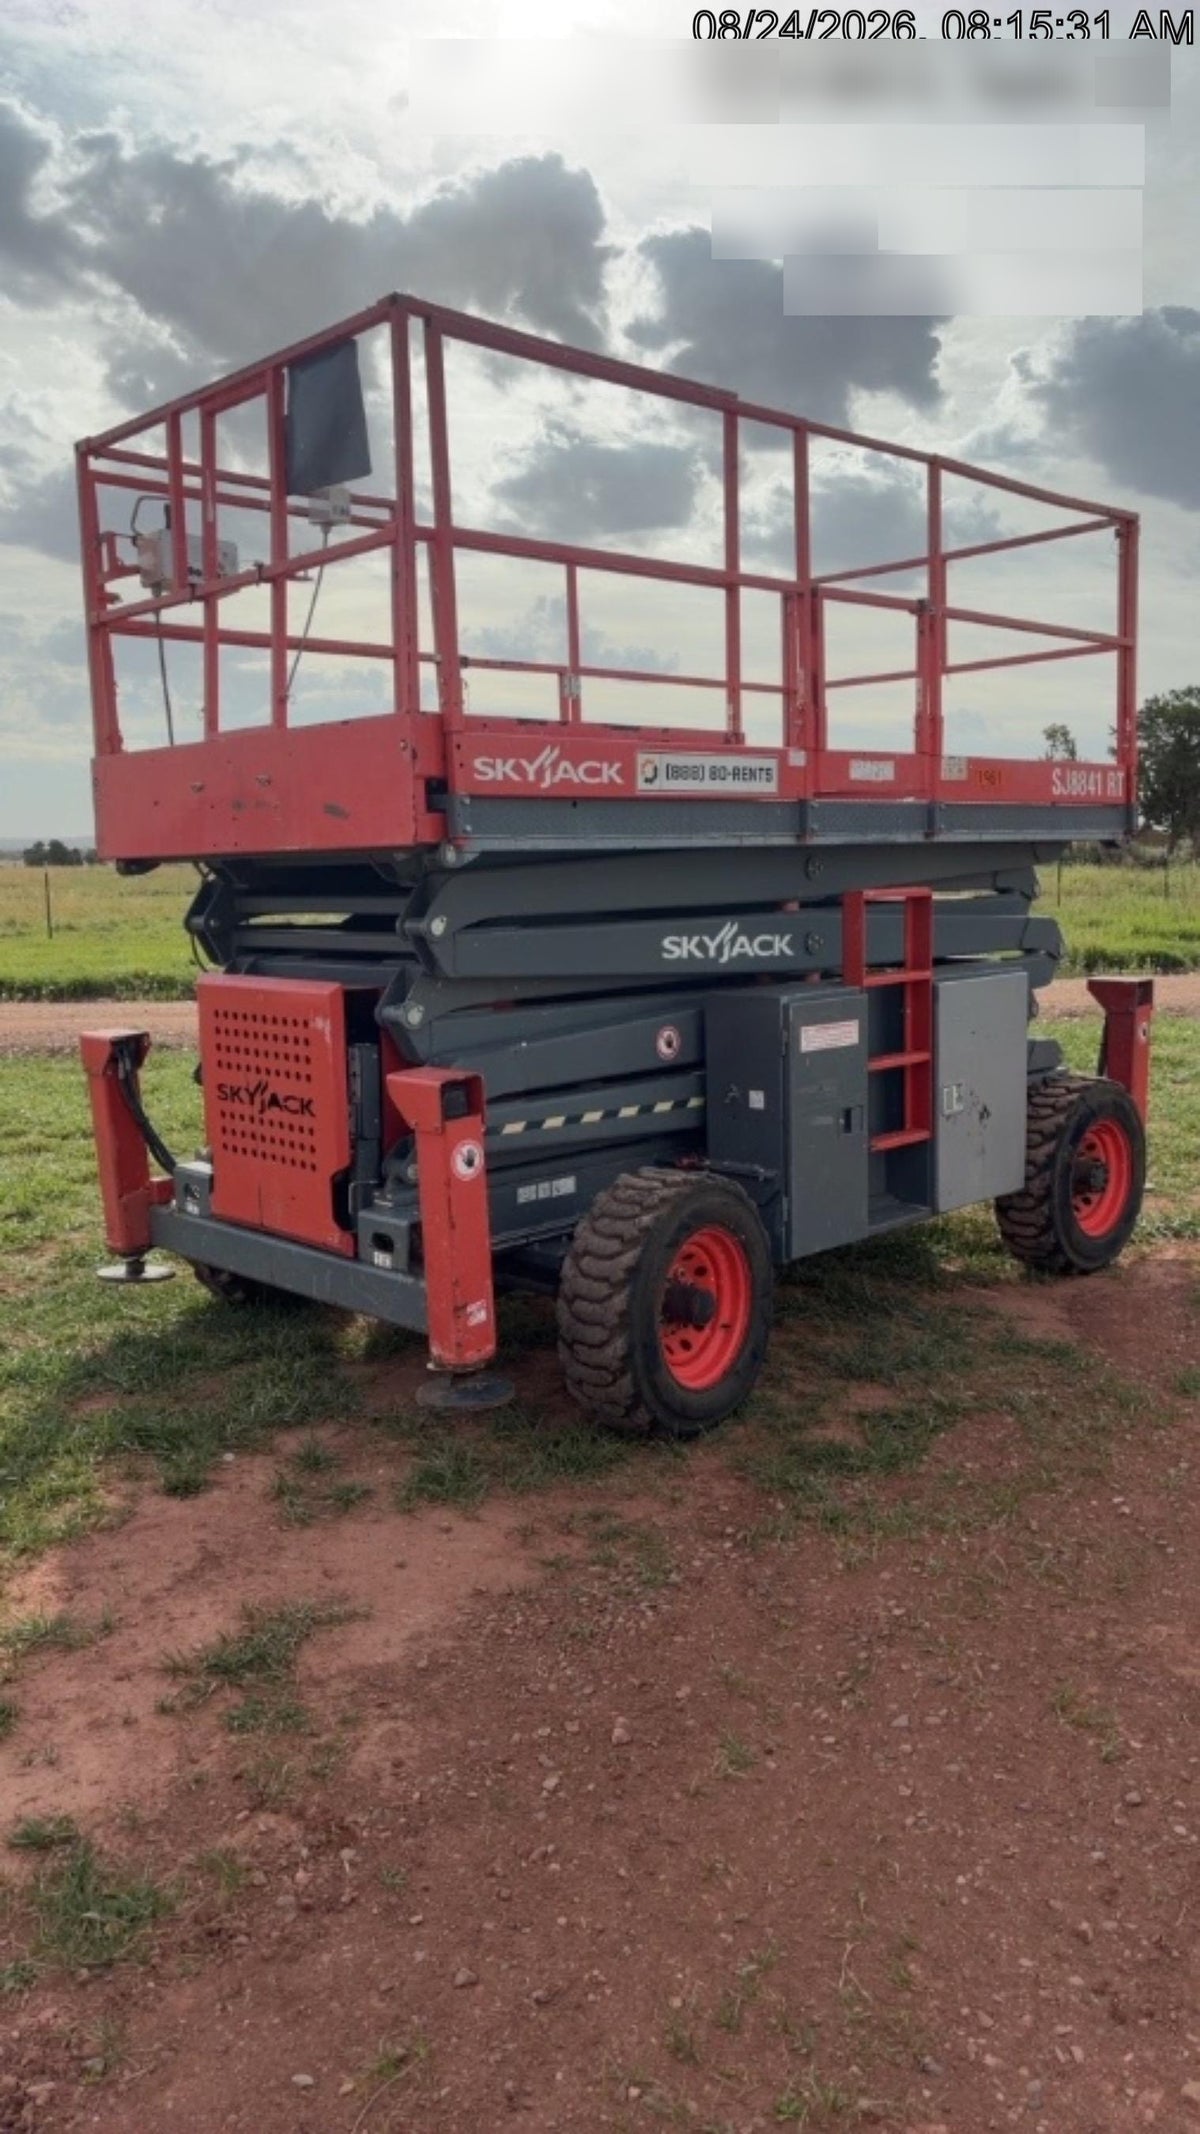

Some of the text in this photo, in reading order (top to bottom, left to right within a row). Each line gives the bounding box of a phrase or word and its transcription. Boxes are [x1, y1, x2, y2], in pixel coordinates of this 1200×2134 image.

[473, 745, 623, 788] SKYJACK
[665, 763, 774, 783] (888) 80-RENTS
[1052, 767, 1125, 797] SJ8841 RT
[661, 922, 793, 963] SKYJACK
[217, 1081, 316, 1117] SKYJACK
